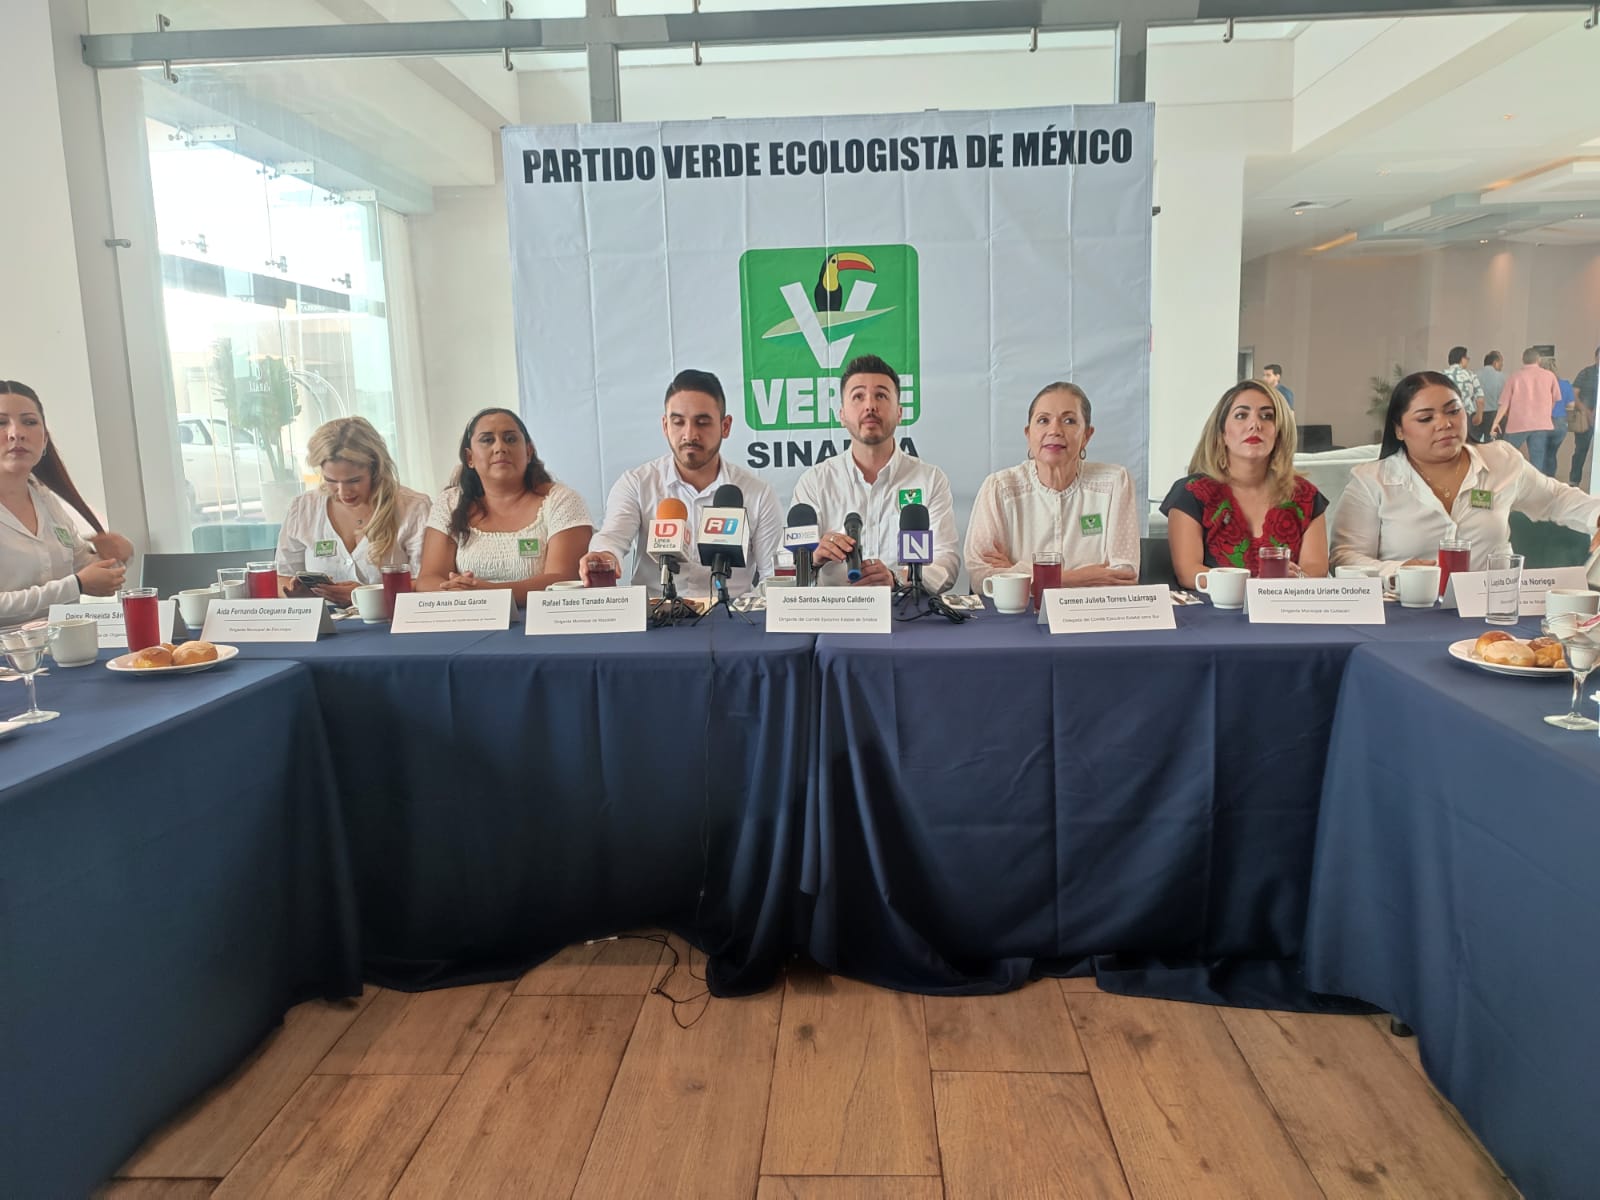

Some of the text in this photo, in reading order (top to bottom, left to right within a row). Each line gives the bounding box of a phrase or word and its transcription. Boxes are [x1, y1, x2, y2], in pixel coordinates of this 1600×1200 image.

[522, 124, 1133, 184] PARTIDO VERDE ECOLOGISTA DE MÉXICO
[751, 374, 914, 425] VERE
[902, 533, 930, 560] LN
[1529, 577, 1556, 587] Noriega
[1257, 587, 1282, 596] Rebeca
[1283, 587, 1315, 597] Alejandra
[1316, 587, 1340, 595] Uriarte
[418, 600, 435, 609] Cindy
[542, 596, 629, 607] Rafael Tadeo Tiznado Alarcón
[782, 594, 875, 605] José Santos Aispuro Calderón
[1058, 593, 1157, 606] Carmen Julieta Torres Lizárraga
[216, 607, 230, 615] Aida
[231, 607, 258, 615] Fernanda
[259, 607, 286, 616] Oceguera
